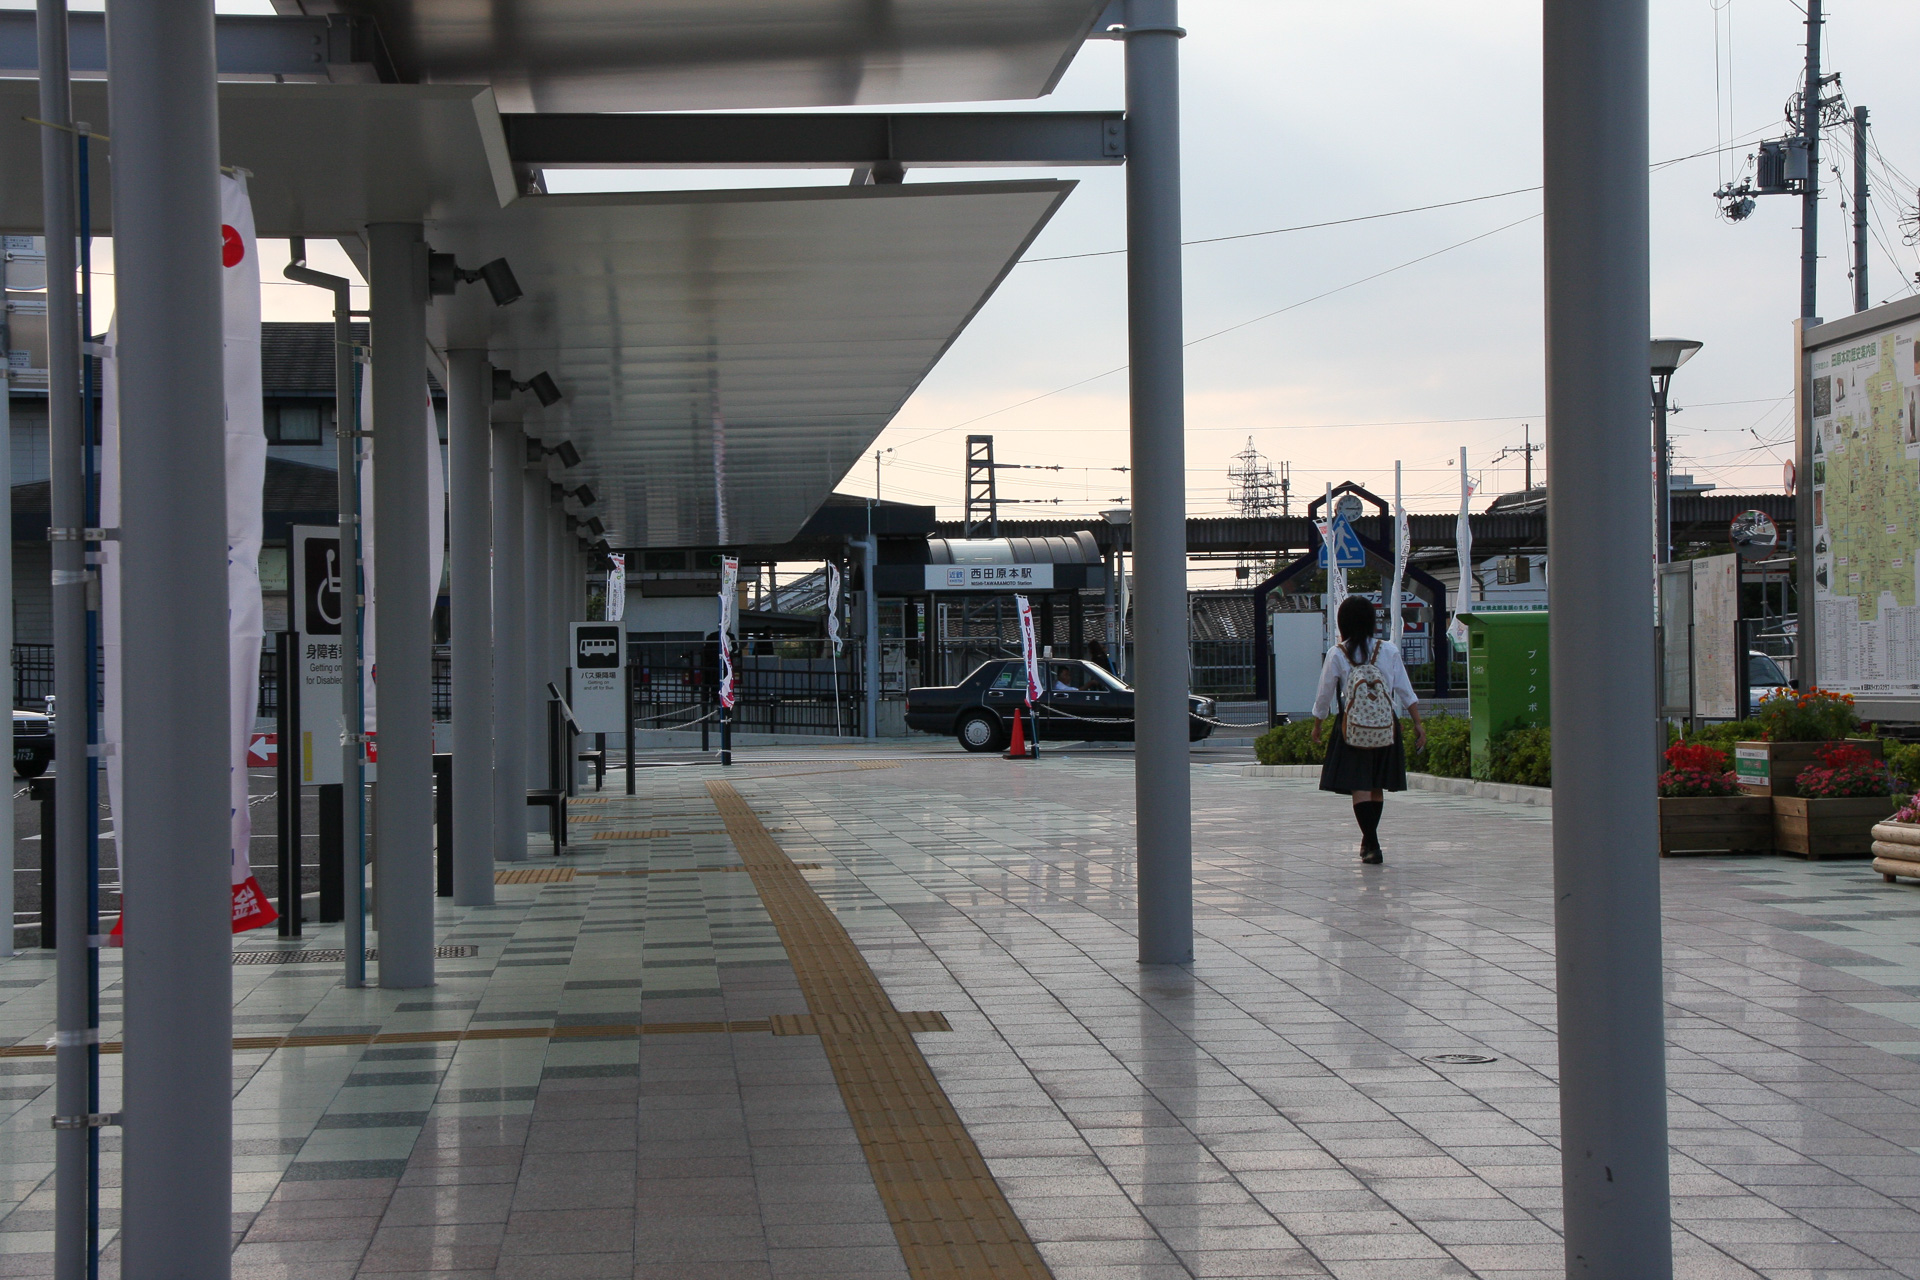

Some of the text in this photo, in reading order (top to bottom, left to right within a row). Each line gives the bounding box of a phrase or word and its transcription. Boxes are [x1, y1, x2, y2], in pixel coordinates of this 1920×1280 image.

[949, 571, 963, 579] 近鉄
[971, 568, 1032, 578] 西田原本駅
[310, 663, 333, 674] Getting
[306, 676, 315, 684] for
